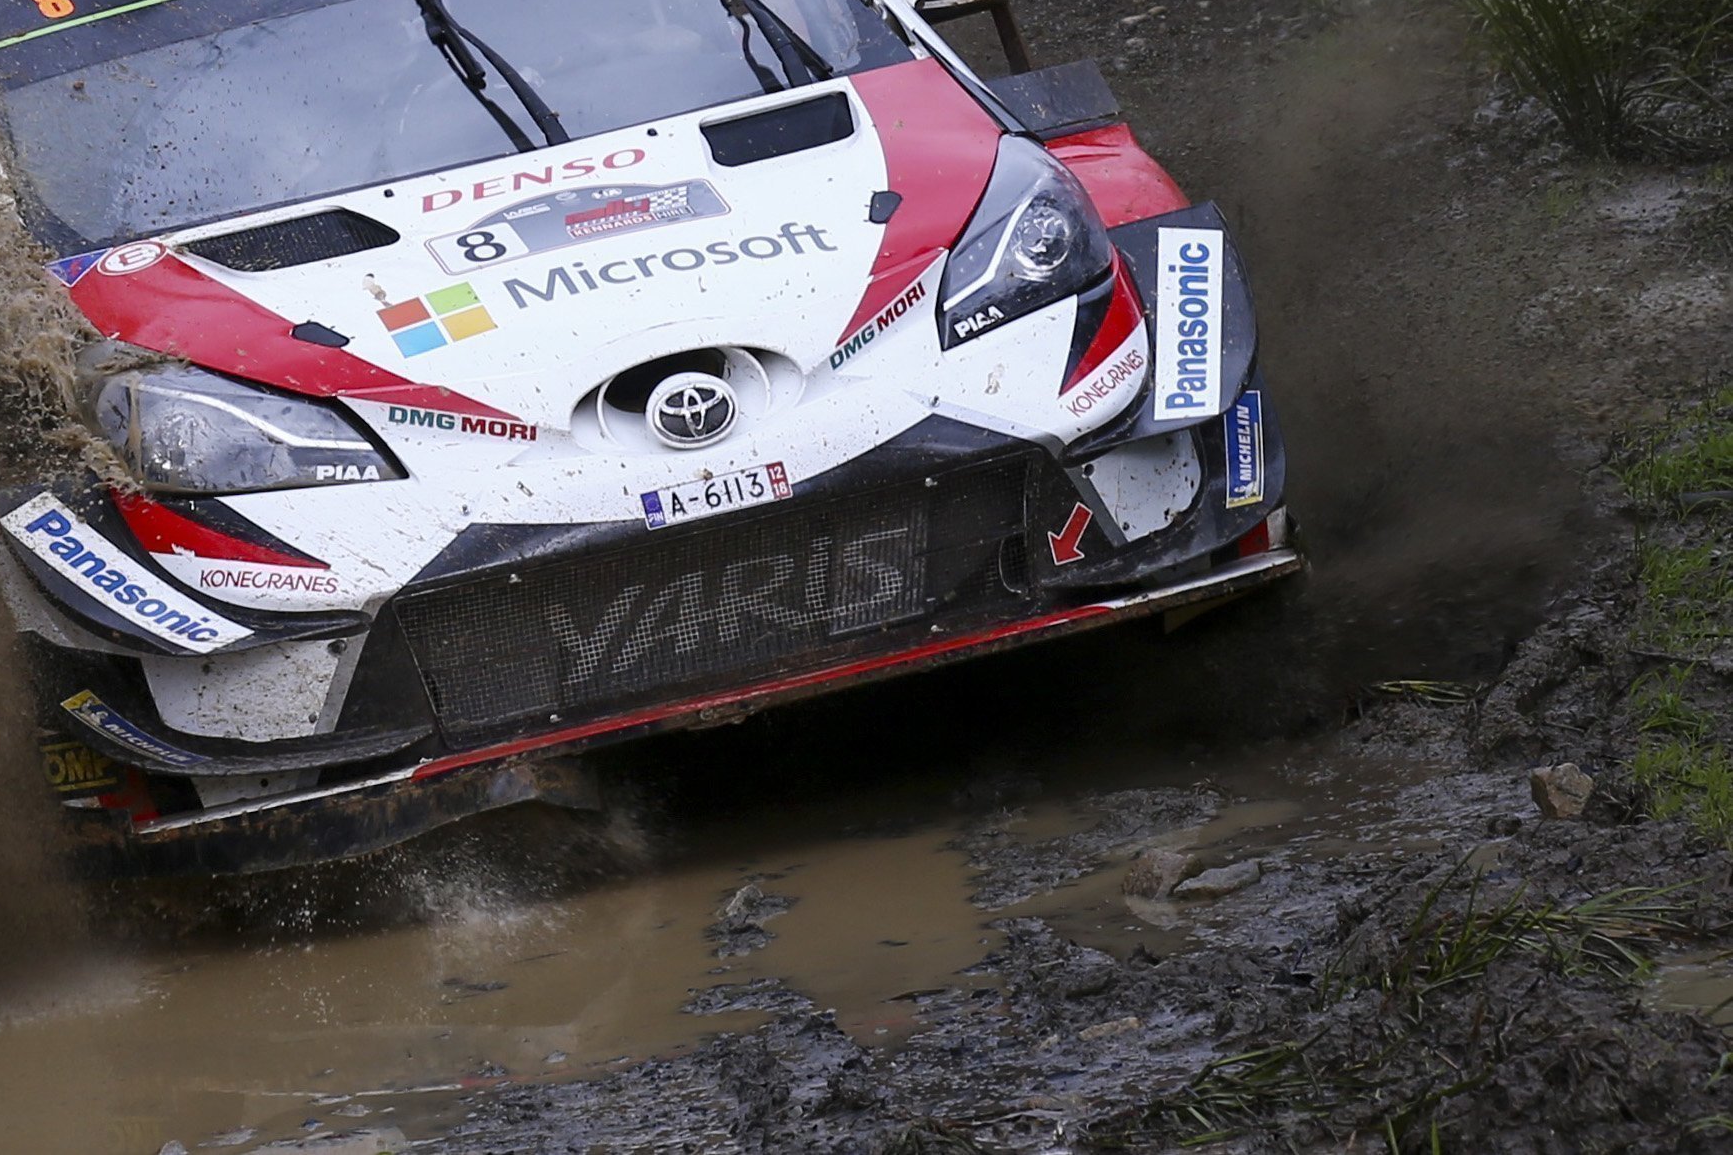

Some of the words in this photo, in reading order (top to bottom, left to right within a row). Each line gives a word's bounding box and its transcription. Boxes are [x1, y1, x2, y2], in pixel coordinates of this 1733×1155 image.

[421, 148, 647, 213] DENSO
[457, 230, 507, 262] 8
[503, 222, 838, 309] Microsoft
[828, 324, 875, 371] DMG
[875, 281, 926, 333] MORI
[953, 305, 1005, 339] PIAA
[1164, 242, 1210, 411] Panasonic
[1066, 348, 1145, 419] KONECRANES
[388, 406, 455, 431] DMG
[461, 417, 537, 442] MORI
[1236, 404, 1252, 482] MICHELIN
[315, 464, 380, 481] PIAA
[671, 471, 765, 517] A-6113
[769, 466, 783, 480] 12
[773, 482, 788, 496] 18
[25, 509, 220, 643] Panasonic
[199, 569, 339, 594] KONECRANES
[544, 526, 910, 686] YARIS
